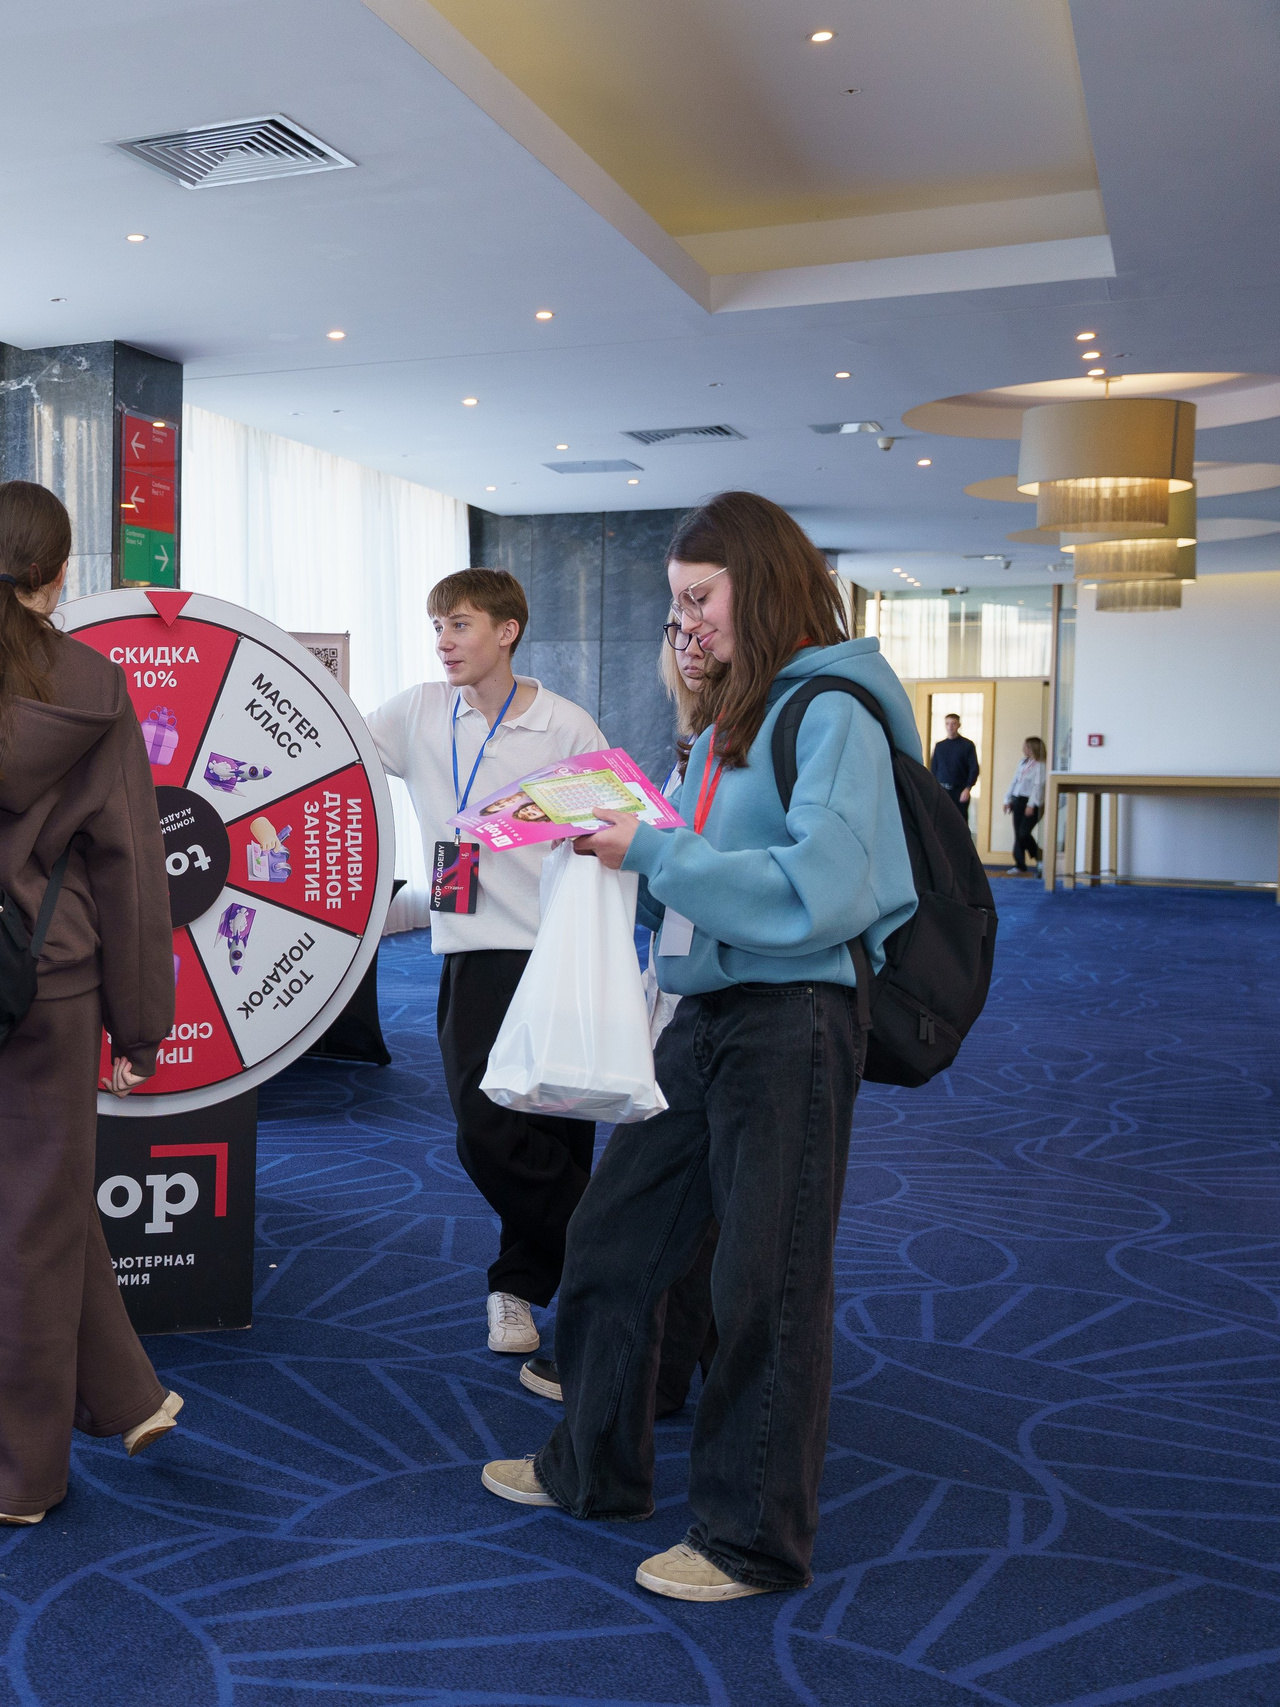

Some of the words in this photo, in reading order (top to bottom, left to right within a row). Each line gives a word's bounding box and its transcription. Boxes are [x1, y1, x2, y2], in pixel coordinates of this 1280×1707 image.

[109, 646, 200, 667] СКИДКА
[133, 671, 177, 688] 10%
[244, 699, 302, 759] КЛАСС
[251, 672, 322, 749] МАСТЕР-
[304, 801, 320, 902] ЗАНЯТИЕ
[323, 791, 342, 910] ДУАЛЬНОЕ
[345, 798, 363, 901] ИНДИВИ-
[436, 844, 445, 884] ACADEMY
[236, 932, 316, 1020] ПОДАРОК
[272, 970, 314, 1011] ТОП-
[97, 1172, 199, 1234] op
[117, 1273, 150, 1286] МИЯ
